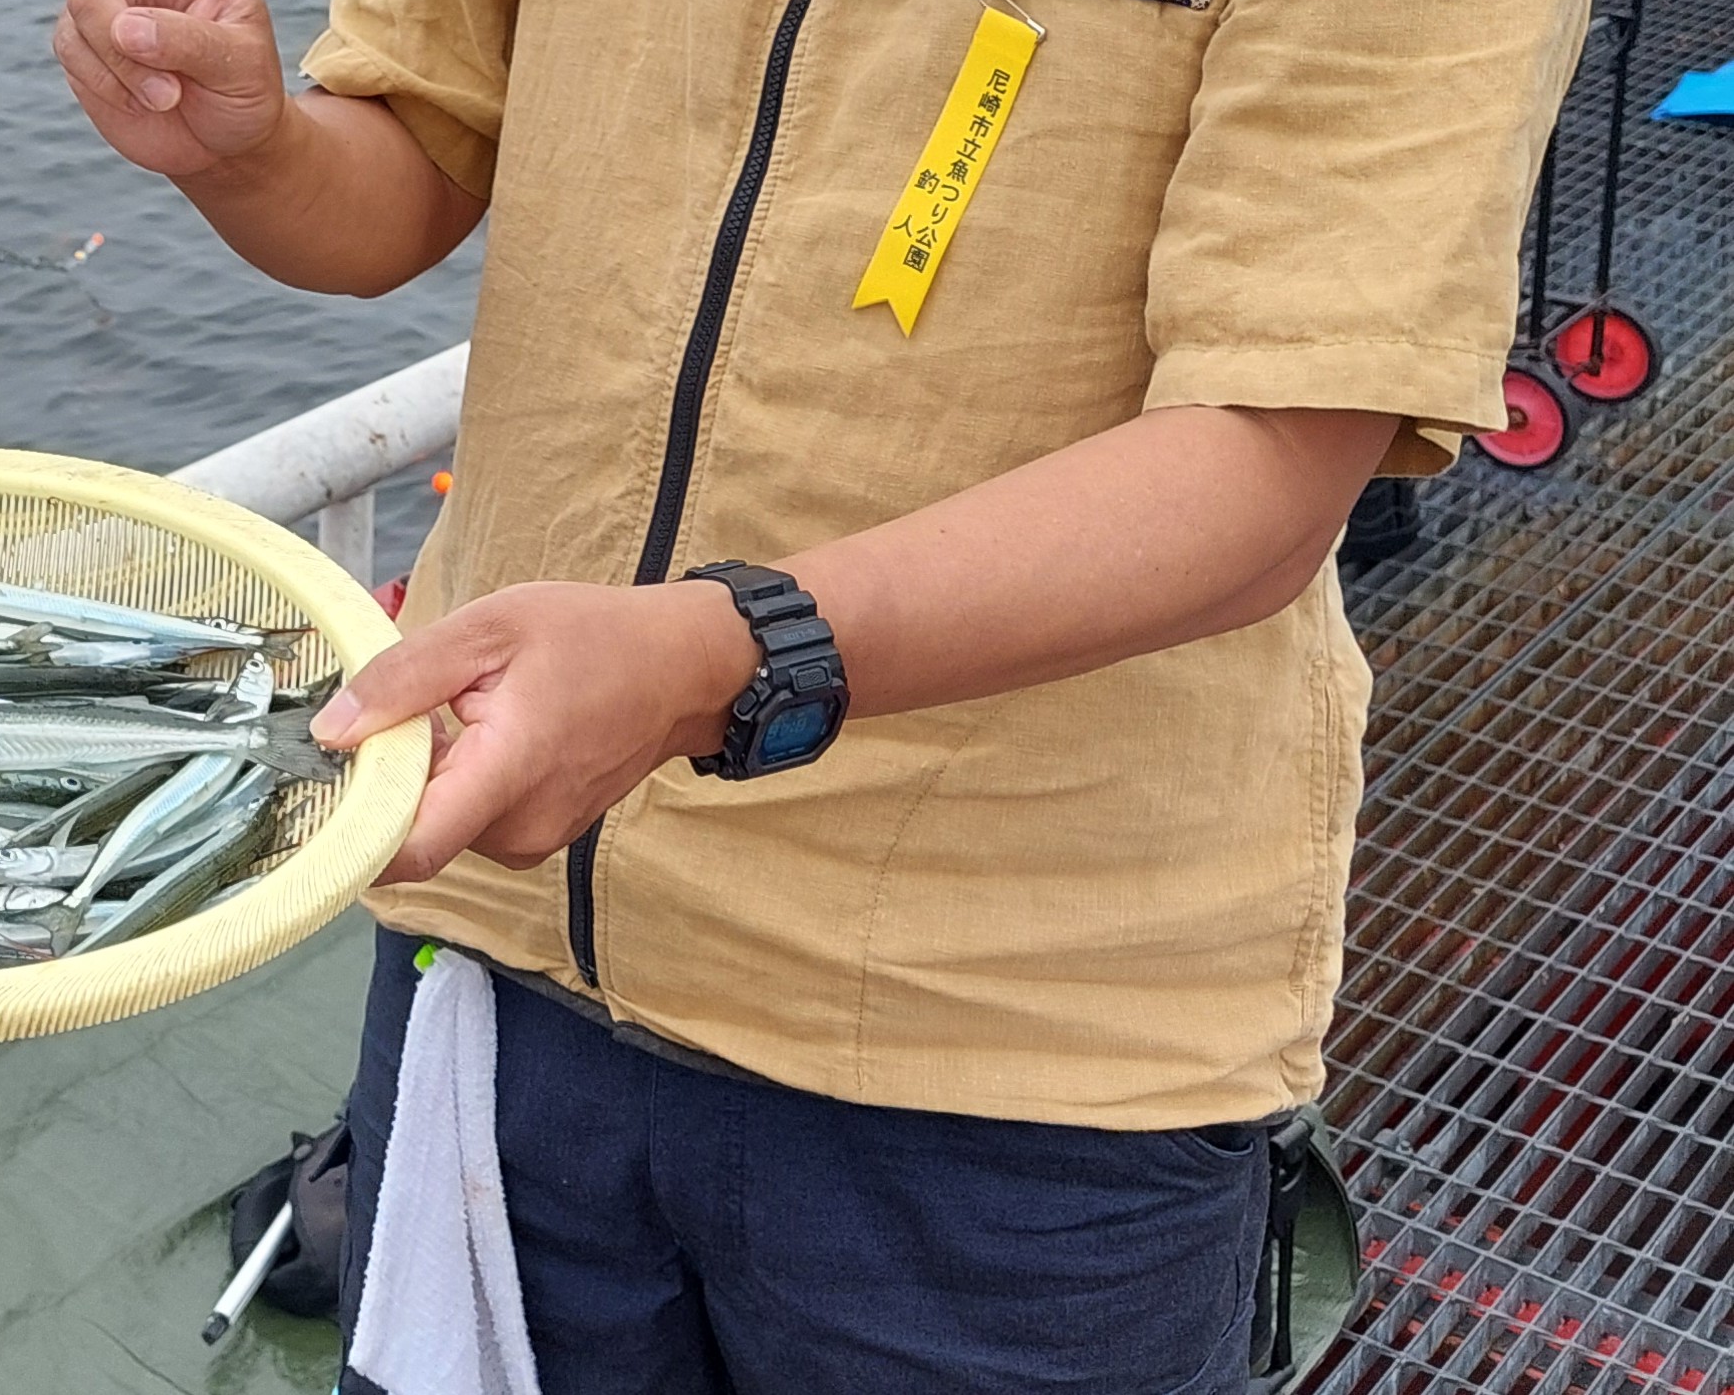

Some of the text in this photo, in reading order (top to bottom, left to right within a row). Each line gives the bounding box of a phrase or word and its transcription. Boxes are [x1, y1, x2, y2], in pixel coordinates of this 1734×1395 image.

[902, 68, 1010, 273] 尼崎市立魚つり公園
